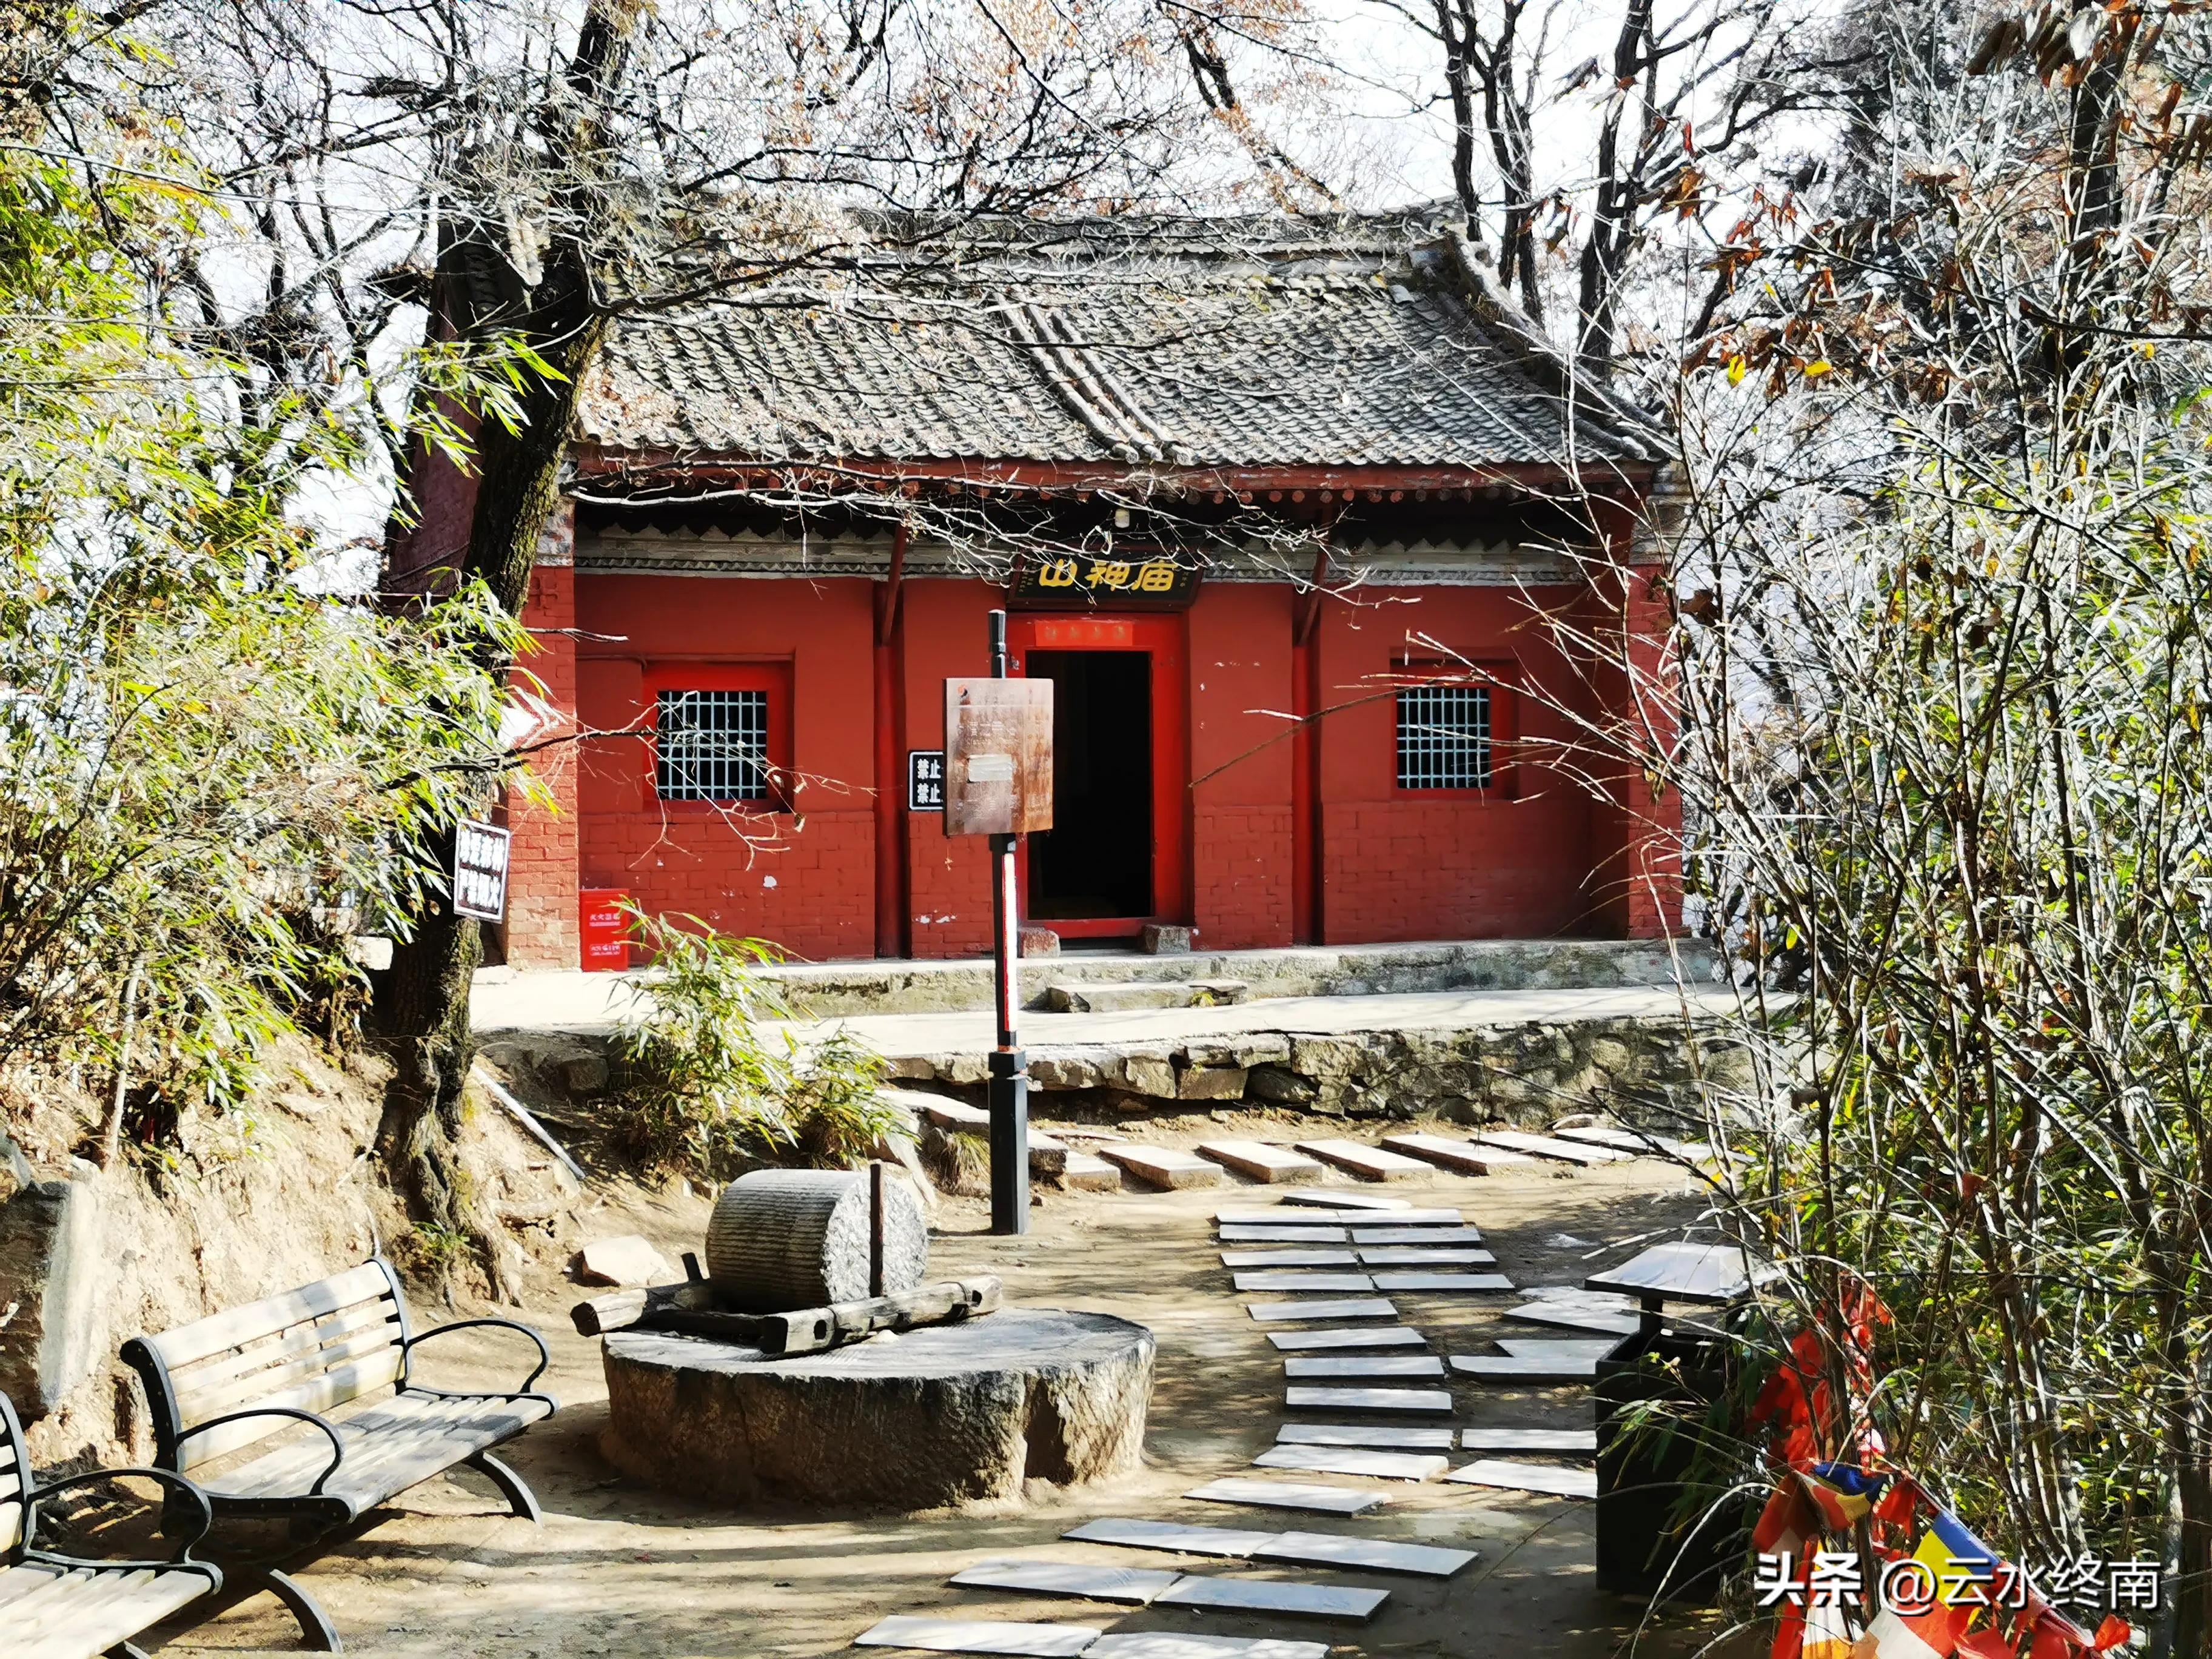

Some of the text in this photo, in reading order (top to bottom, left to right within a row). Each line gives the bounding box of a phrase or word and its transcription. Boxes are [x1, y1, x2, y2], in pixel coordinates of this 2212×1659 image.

[1038, 558, 1179, 592] 山神庙
[458, 868, 501, 908] 严禁烟火
